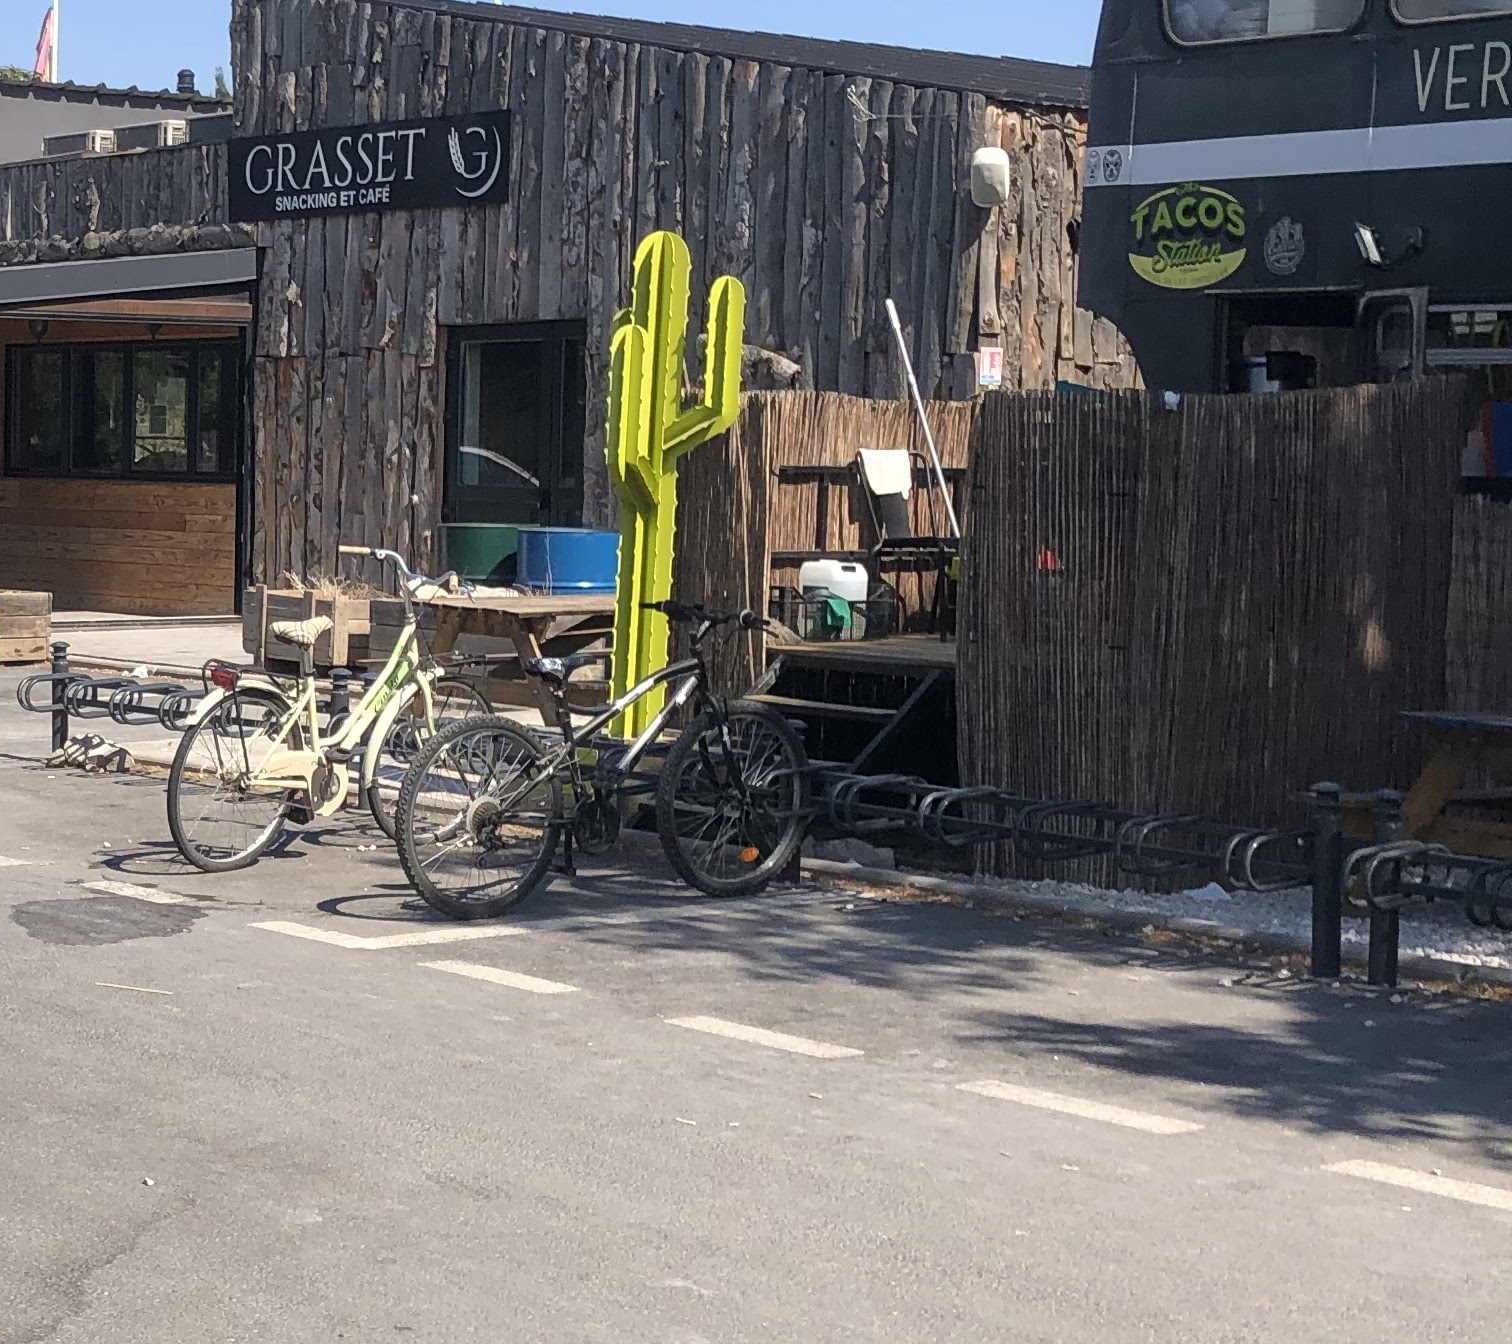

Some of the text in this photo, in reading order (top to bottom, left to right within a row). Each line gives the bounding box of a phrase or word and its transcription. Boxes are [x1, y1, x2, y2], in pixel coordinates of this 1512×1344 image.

[1413, 41, 1511, 112] VER
[245, 127, 426, 195] GRASSET
[275, 184, 390, 211] SNACKING ET CAFÉ
[1130, 197, 1246, 240] TACOS
[1152, 238, 1221, 273] Station
